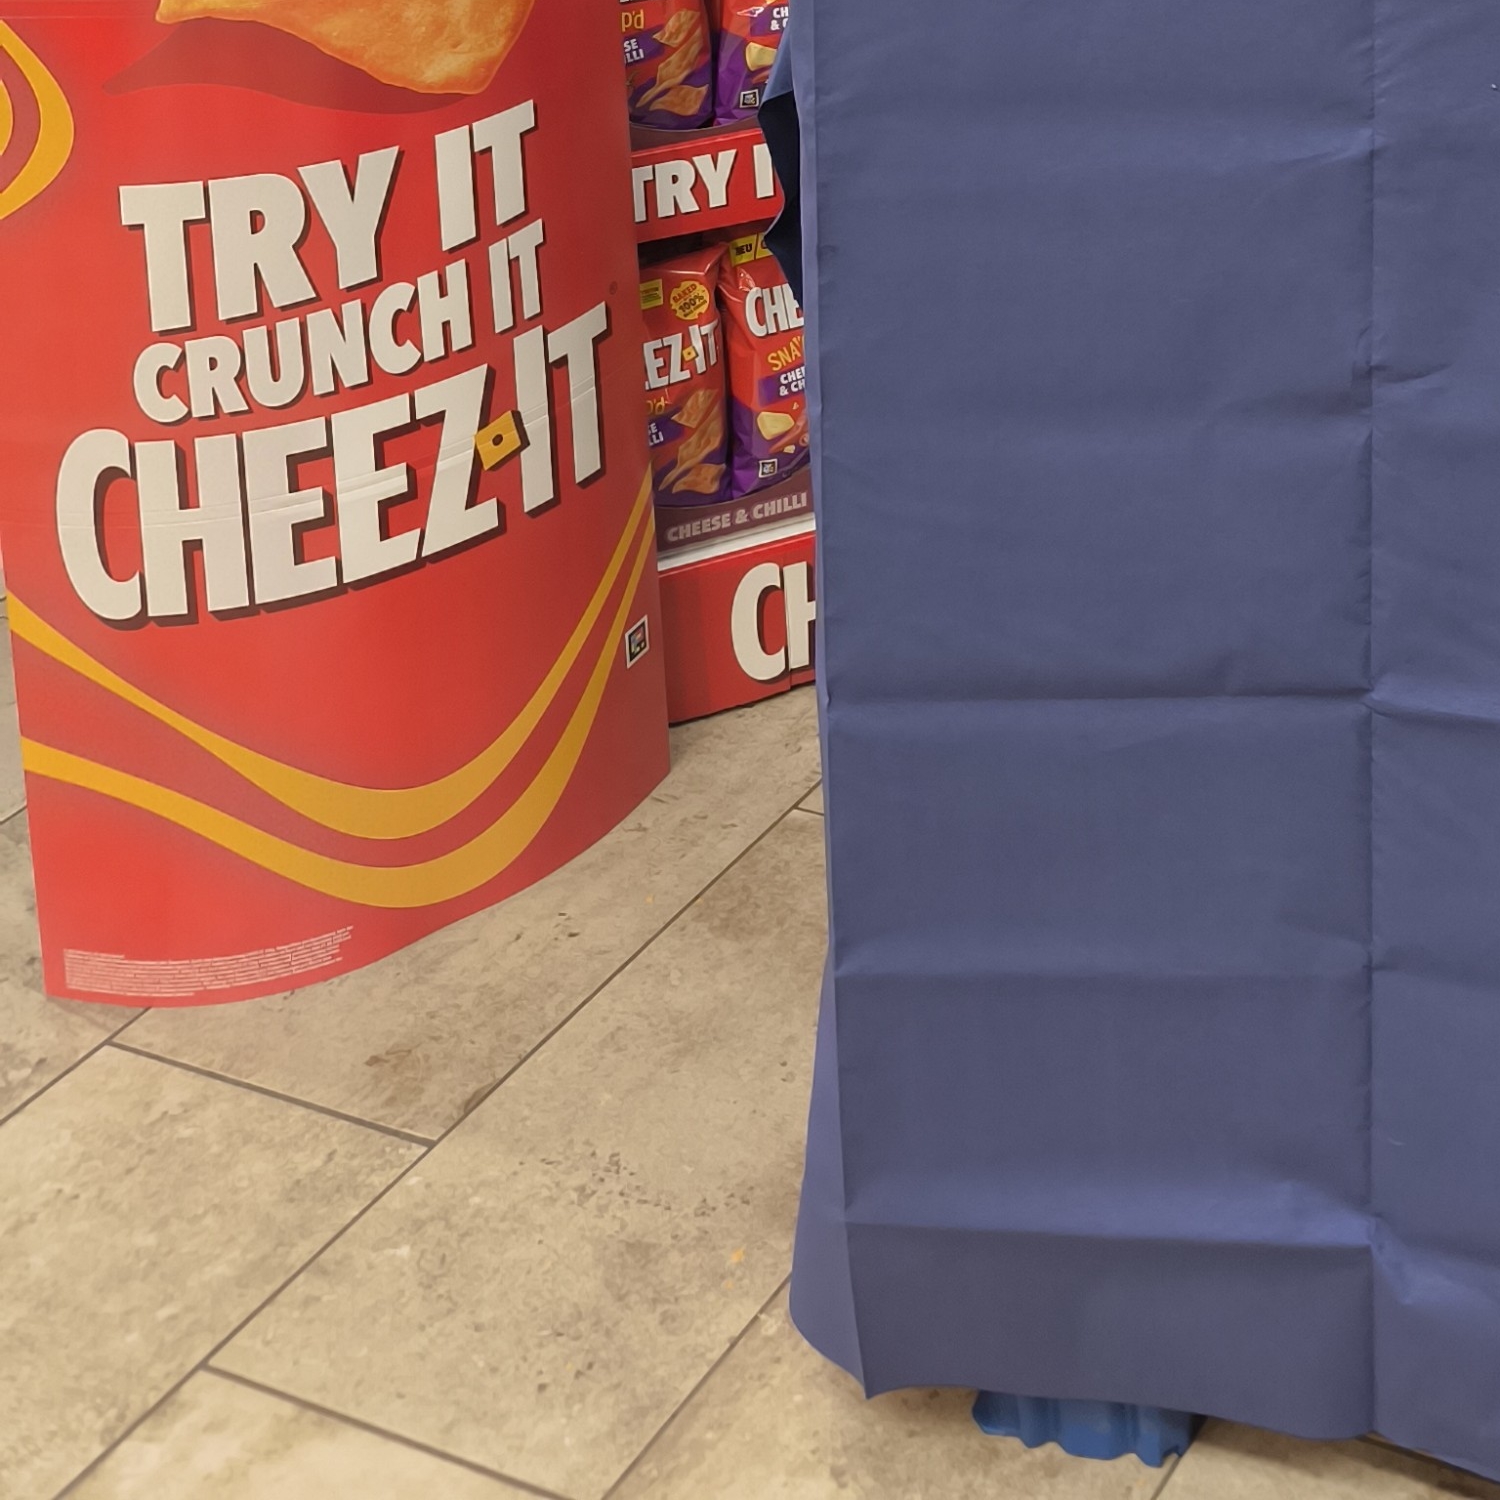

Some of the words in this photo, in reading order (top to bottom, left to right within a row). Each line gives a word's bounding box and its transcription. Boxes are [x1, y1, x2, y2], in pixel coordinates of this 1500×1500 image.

[119, 146, 401, 333] TRY
[434, 101, 536, 252] IT
[632, 149, 738, 223] TRY
[133, 255, 474, 425] CRUNCH
[487, 220, 544, 333] IT
[678, 292, 705, 314] 100%
[667, 514, 732, 542] CHEESE
[736, 508, 749, 525] &
[752, 493, 808, 520] CHILLI
